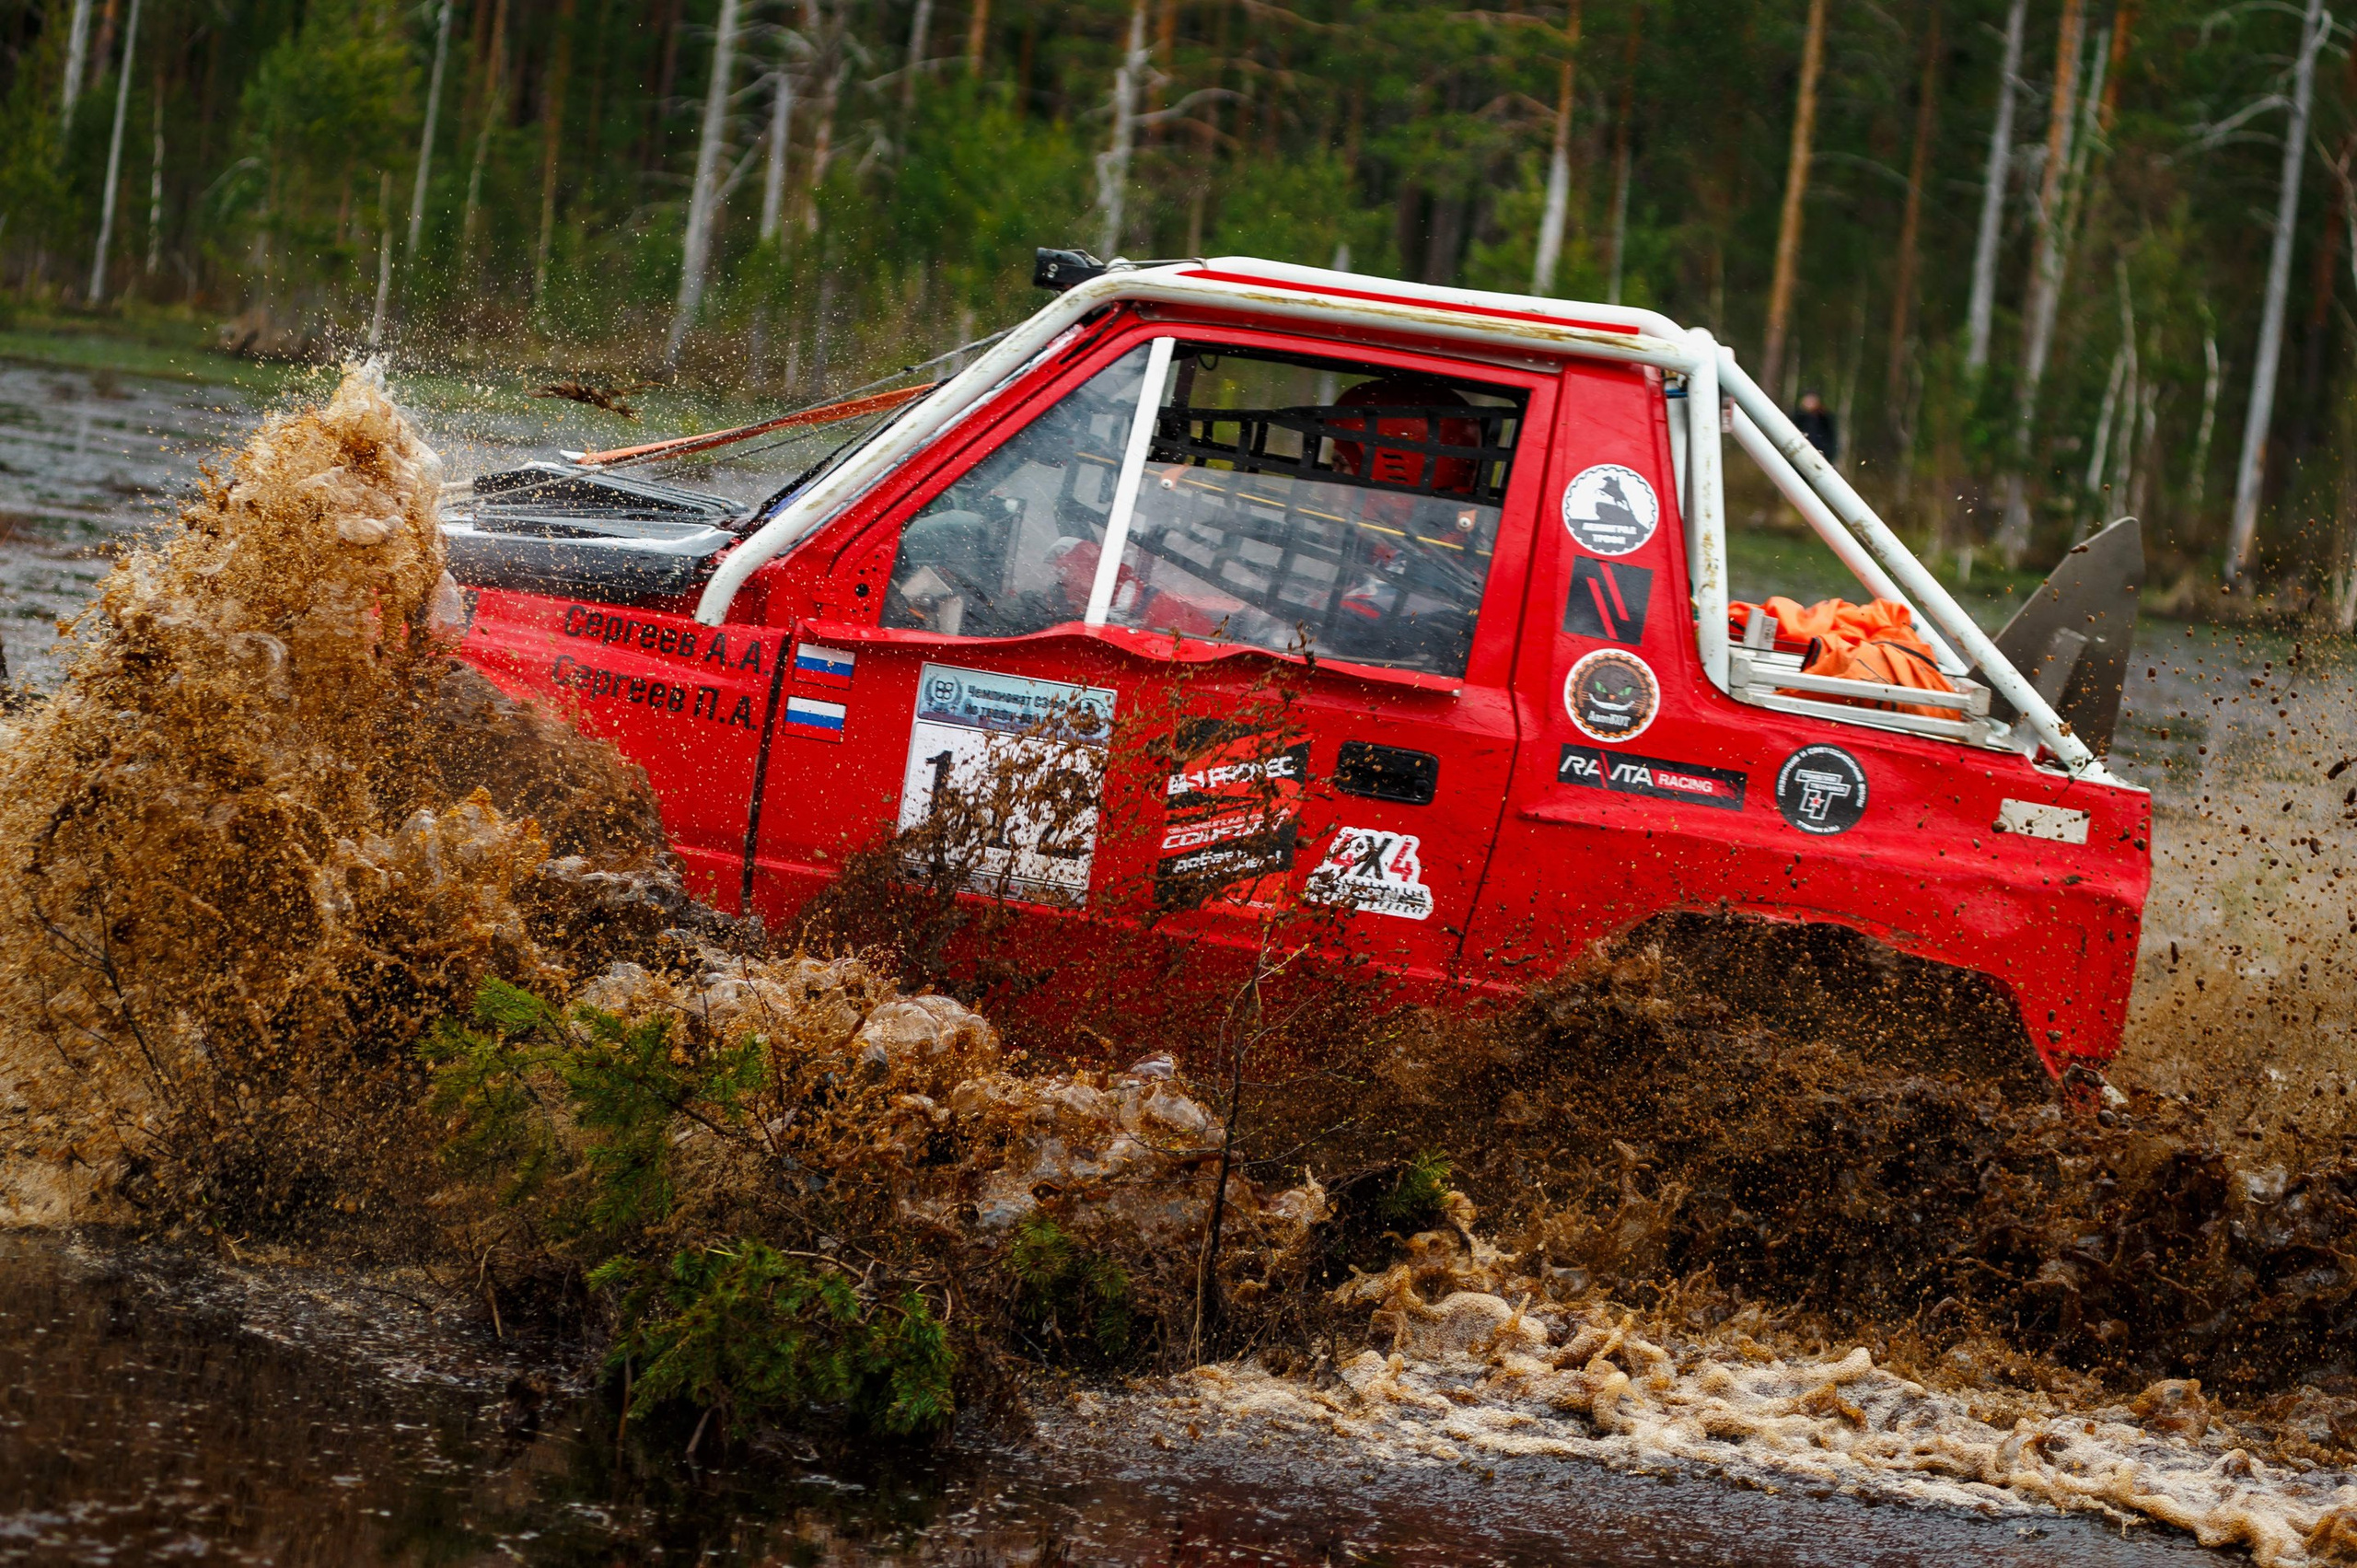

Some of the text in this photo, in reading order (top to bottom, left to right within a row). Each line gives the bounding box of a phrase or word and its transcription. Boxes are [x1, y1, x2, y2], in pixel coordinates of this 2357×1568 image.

[564, 604, 696, 657] Сергеев
[552, 654, 684, 713] Сергеев
[1658, 772, 1714, 793] RACING
